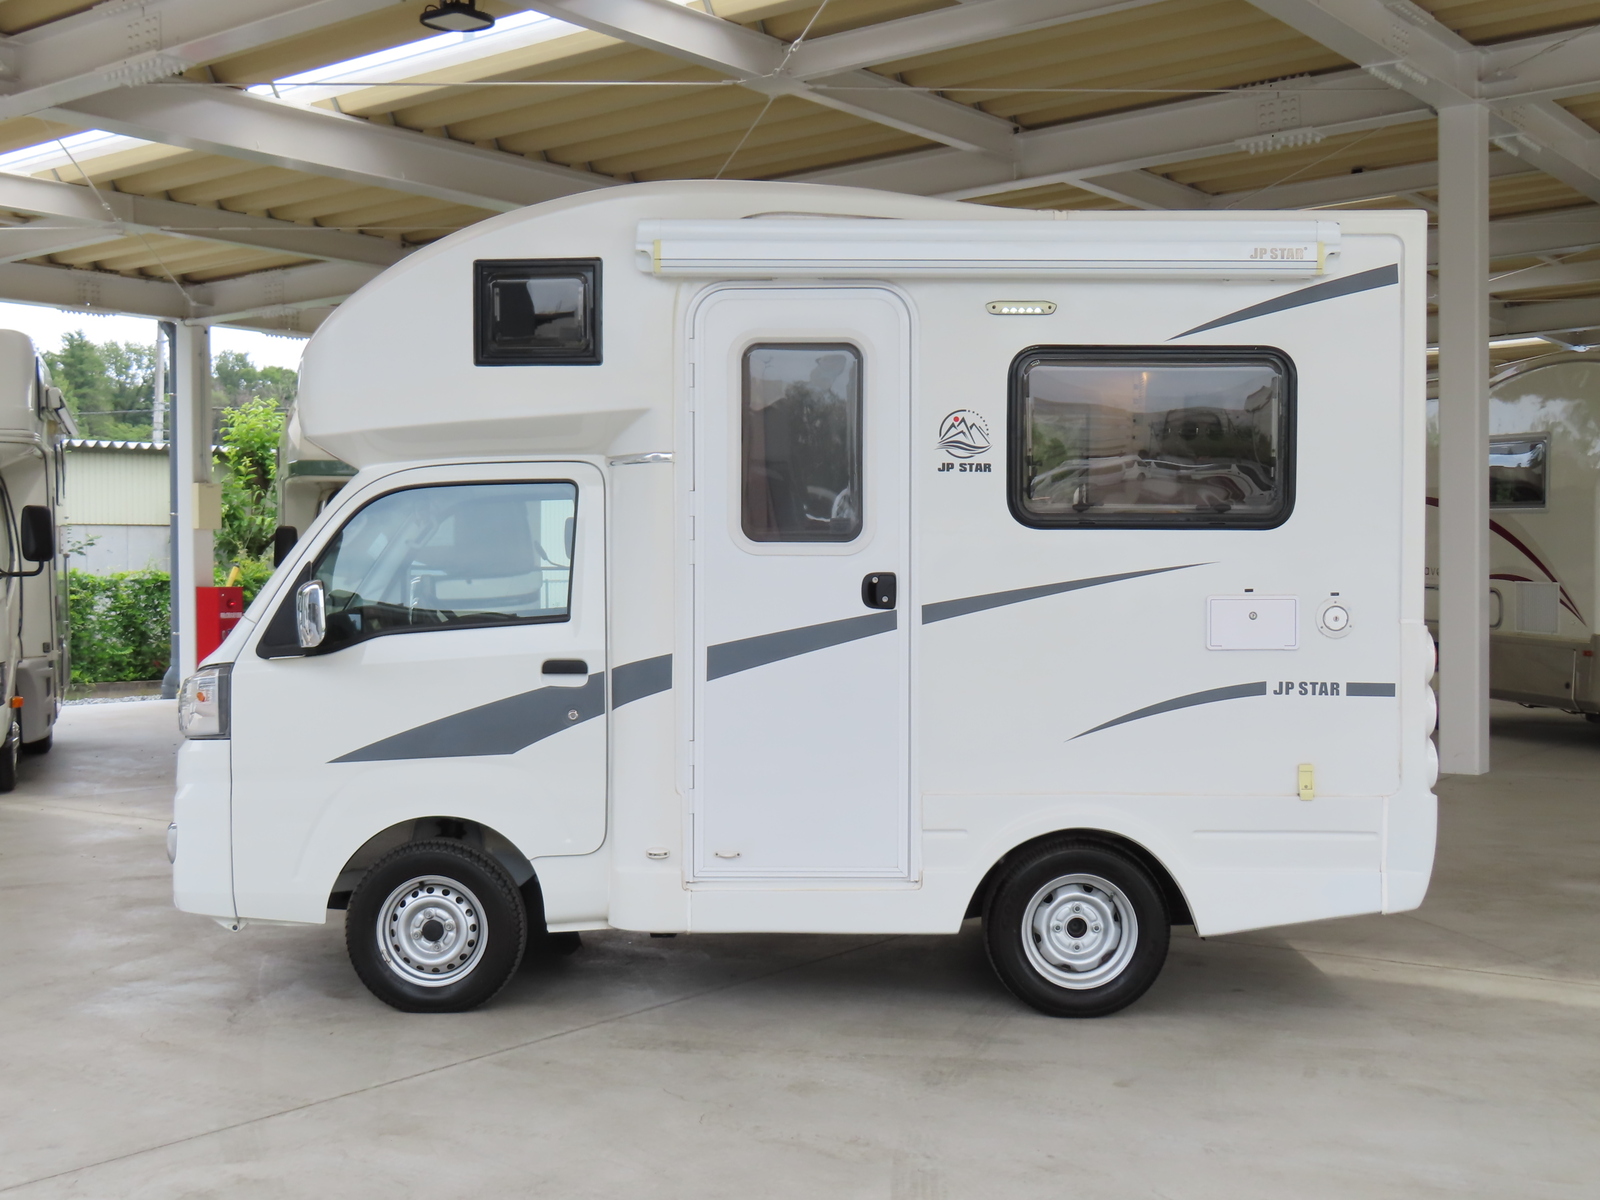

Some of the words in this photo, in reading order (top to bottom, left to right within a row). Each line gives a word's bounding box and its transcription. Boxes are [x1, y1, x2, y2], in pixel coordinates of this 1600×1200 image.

[1249, 247, 1267, 260] JP
[1269, 247, 1304, 260] STAR
[937, 462, 955, 473] JP
[958, 462, 992, 473] STAR
[1273, 681, 1295, 696] JP
[1298, 681, 1340, 697] STAR
